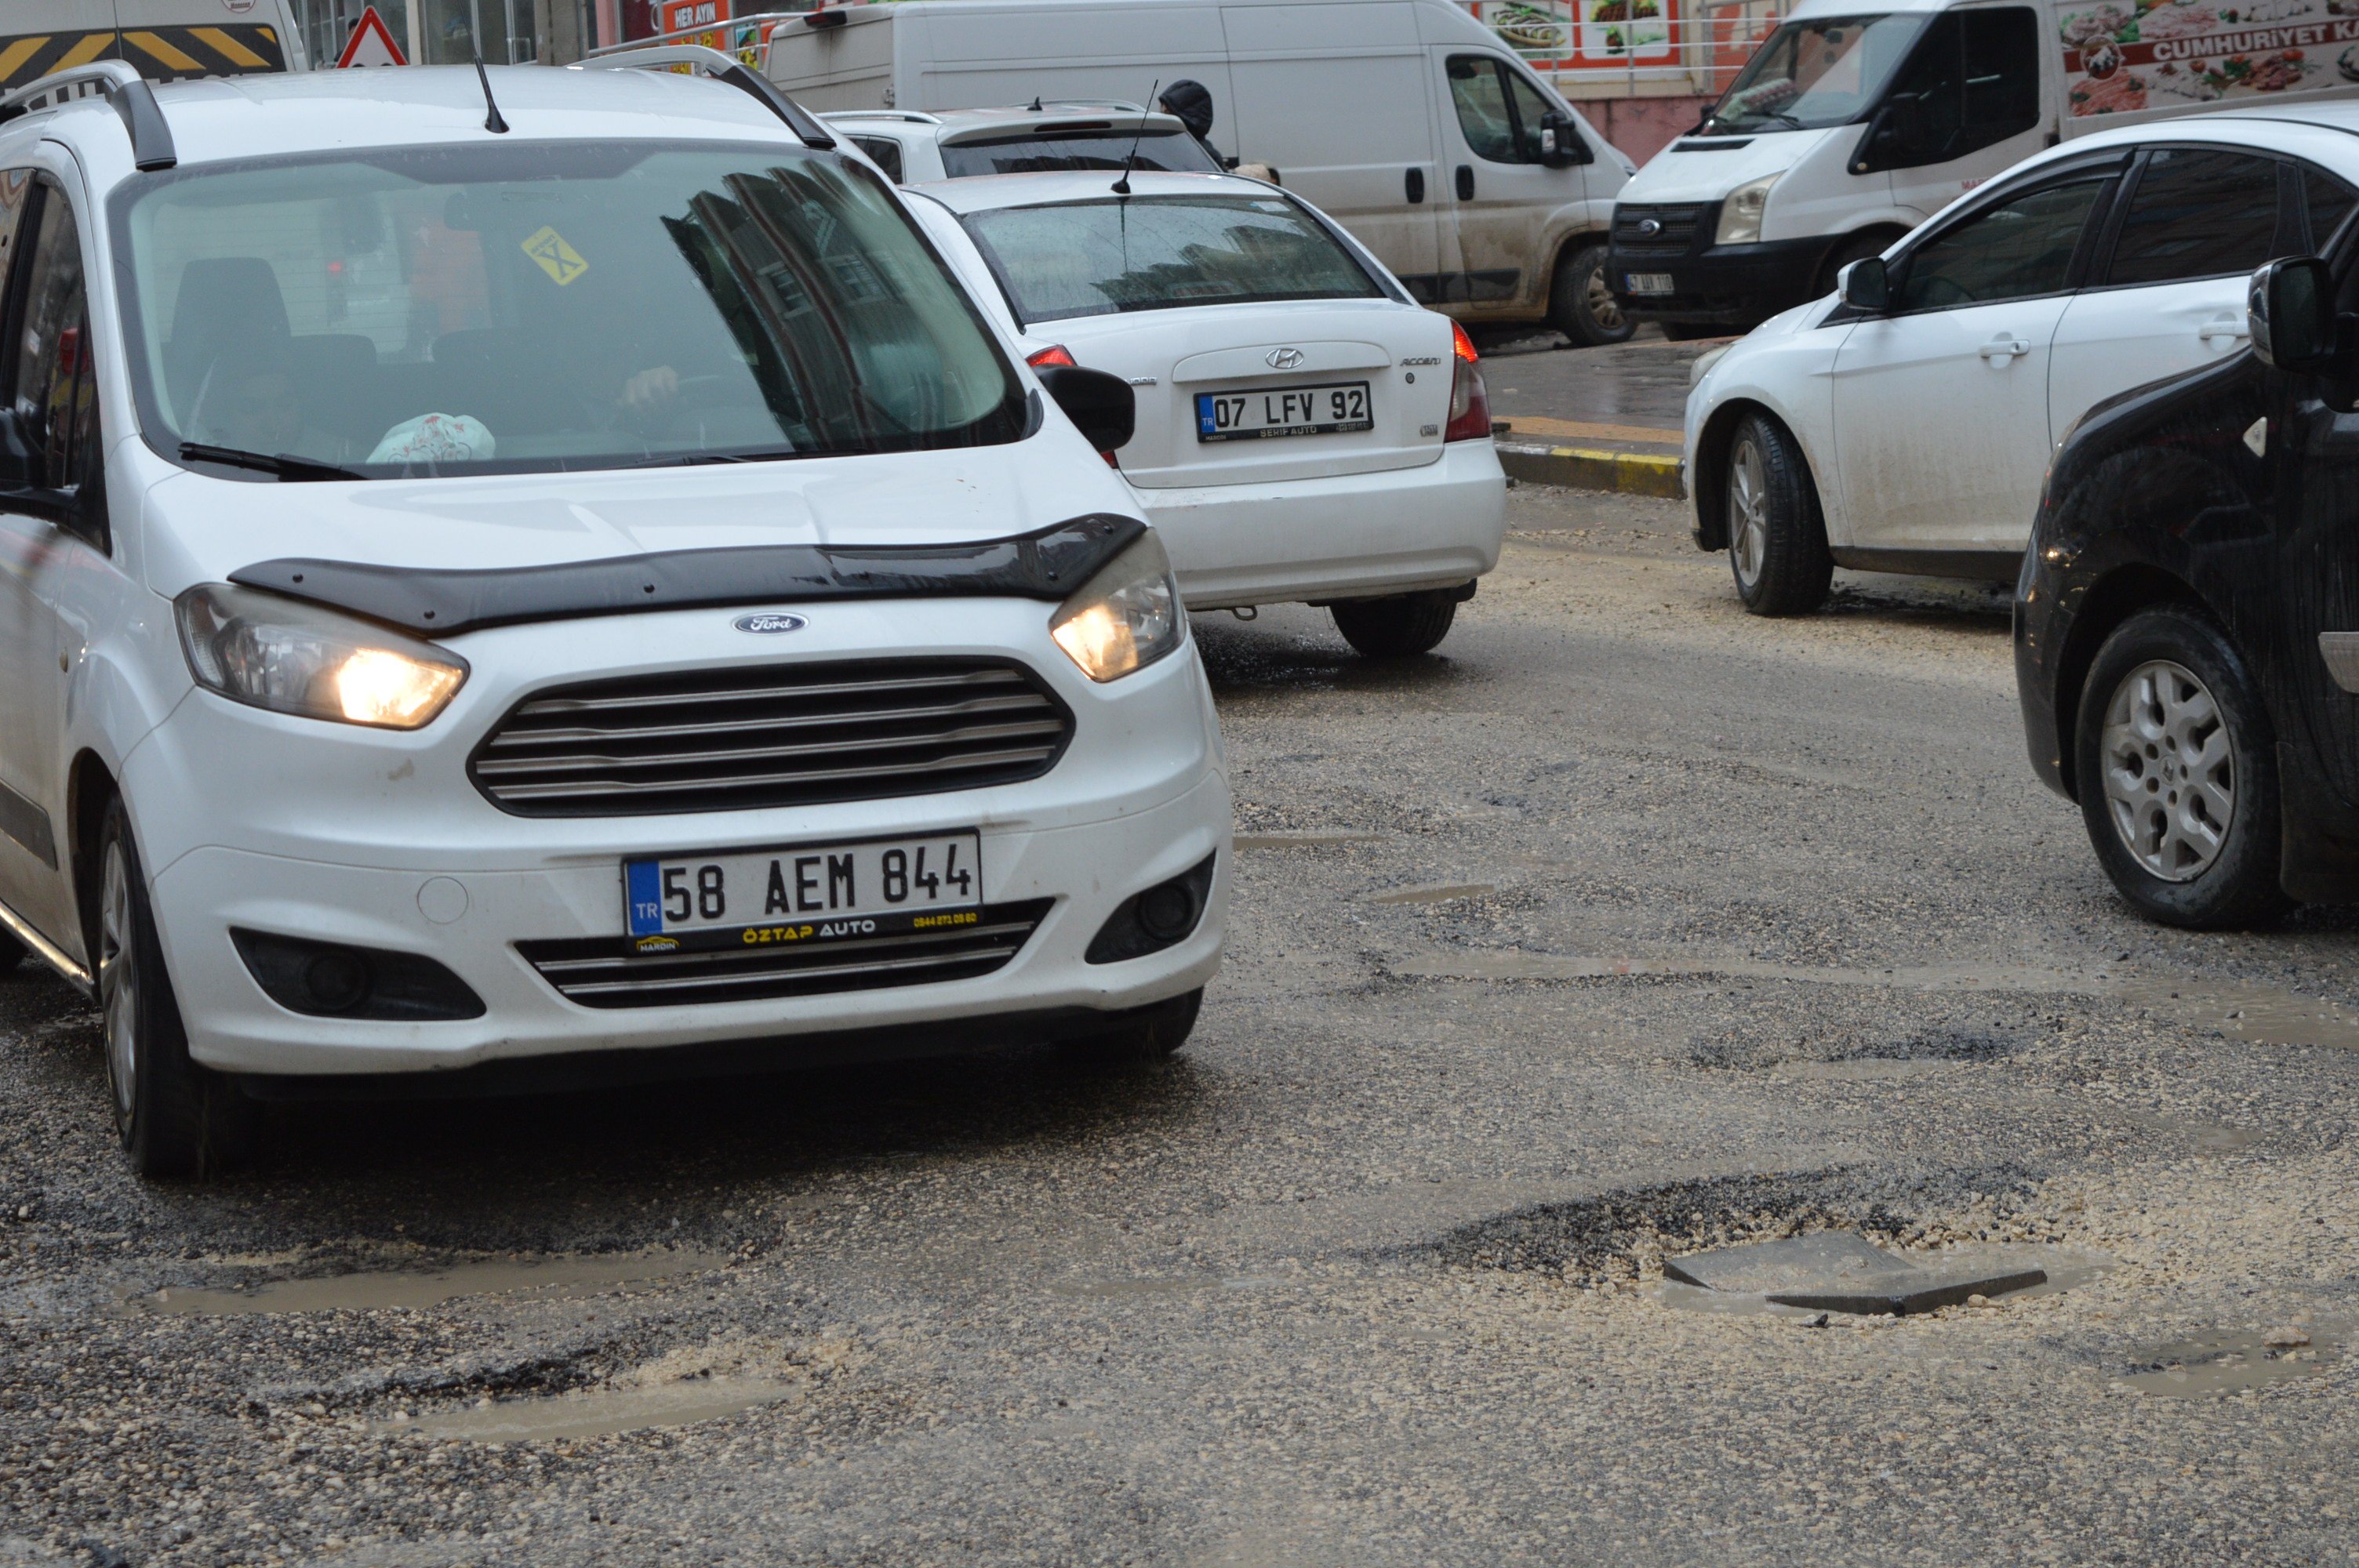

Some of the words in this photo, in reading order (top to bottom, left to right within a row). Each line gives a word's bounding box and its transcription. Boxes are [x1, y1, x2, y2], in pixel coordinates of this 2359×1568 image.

[675, 6, 693, 28] HER
[696, 2, 716, 25] AYIN
[2153, 24, 2327, 61] CUMHURİYET
[1214, 398, 1246, 428] 07
[1265, 393, 1314, 425] LFV
[1331, 390, 1364, 419] 92
[1202, 417, 1214, 426] TR
[1290, 425, 1318, 436] AUTO
[750, 616, 792, 631] Ford
[662, 865, 725, 923] 58
[764, 852, 856, 915] AEM
[881, 844, 972, 903] 844
[635, 902, 659, 919] TR
[742, 924, 814, 943] ÖZTAP
[819, 919, 876, 938] AUTO
